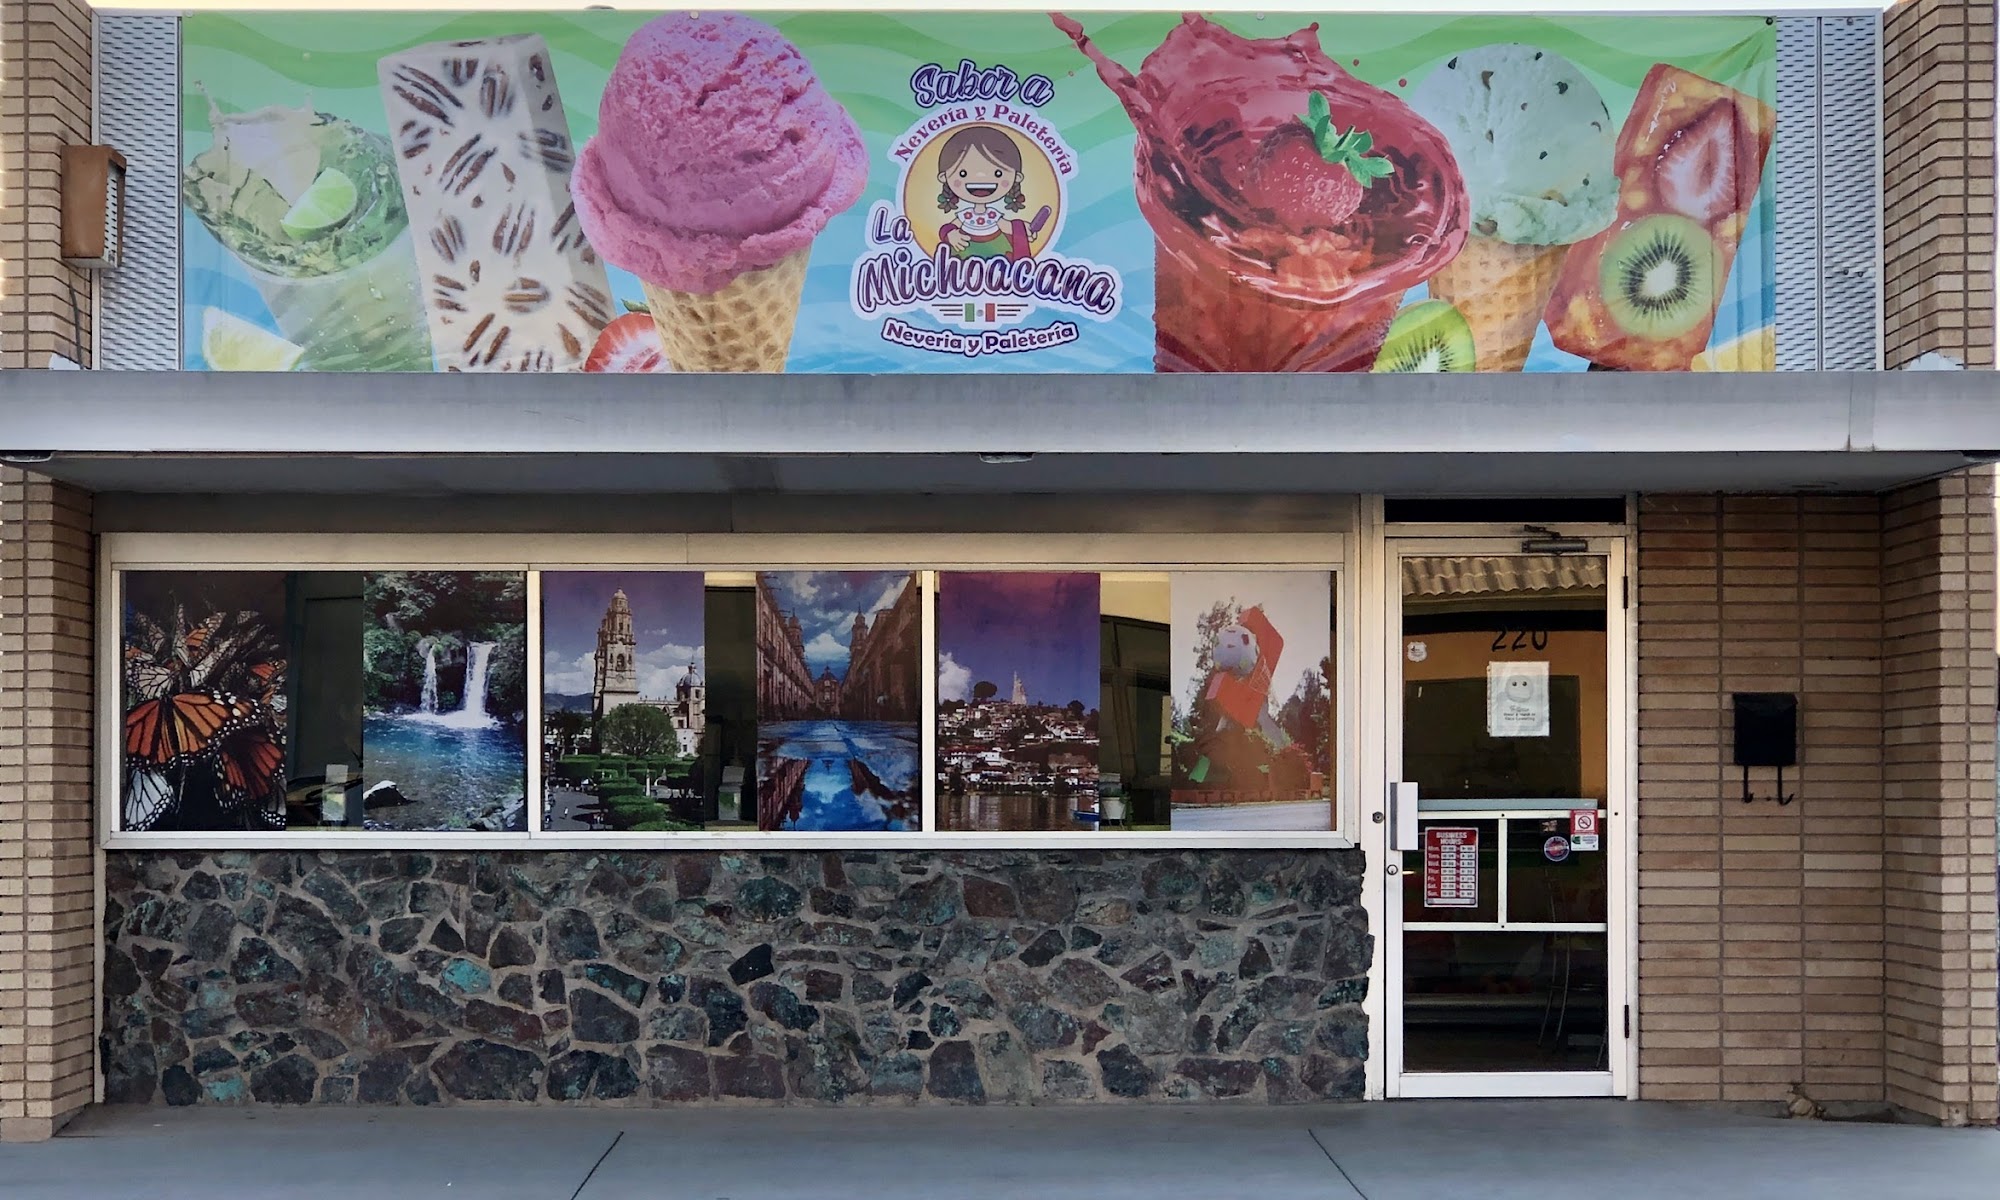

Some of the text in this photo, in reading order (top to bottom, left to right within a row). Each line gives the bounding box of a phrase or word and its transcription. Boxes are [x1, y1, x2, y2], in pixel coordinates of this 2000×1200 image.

[911, 59, 1054, 108] Sabor a
[894, 103, 1073, 175] Nevería y Paletería
[873, 206, 913, 244] La
[857, 243, 1116, 313] Michoacana
[967, 338, 980, 353] y
[985, 323, 1075, 350] Paletería
[1491, 627, 1548, 652] 220
